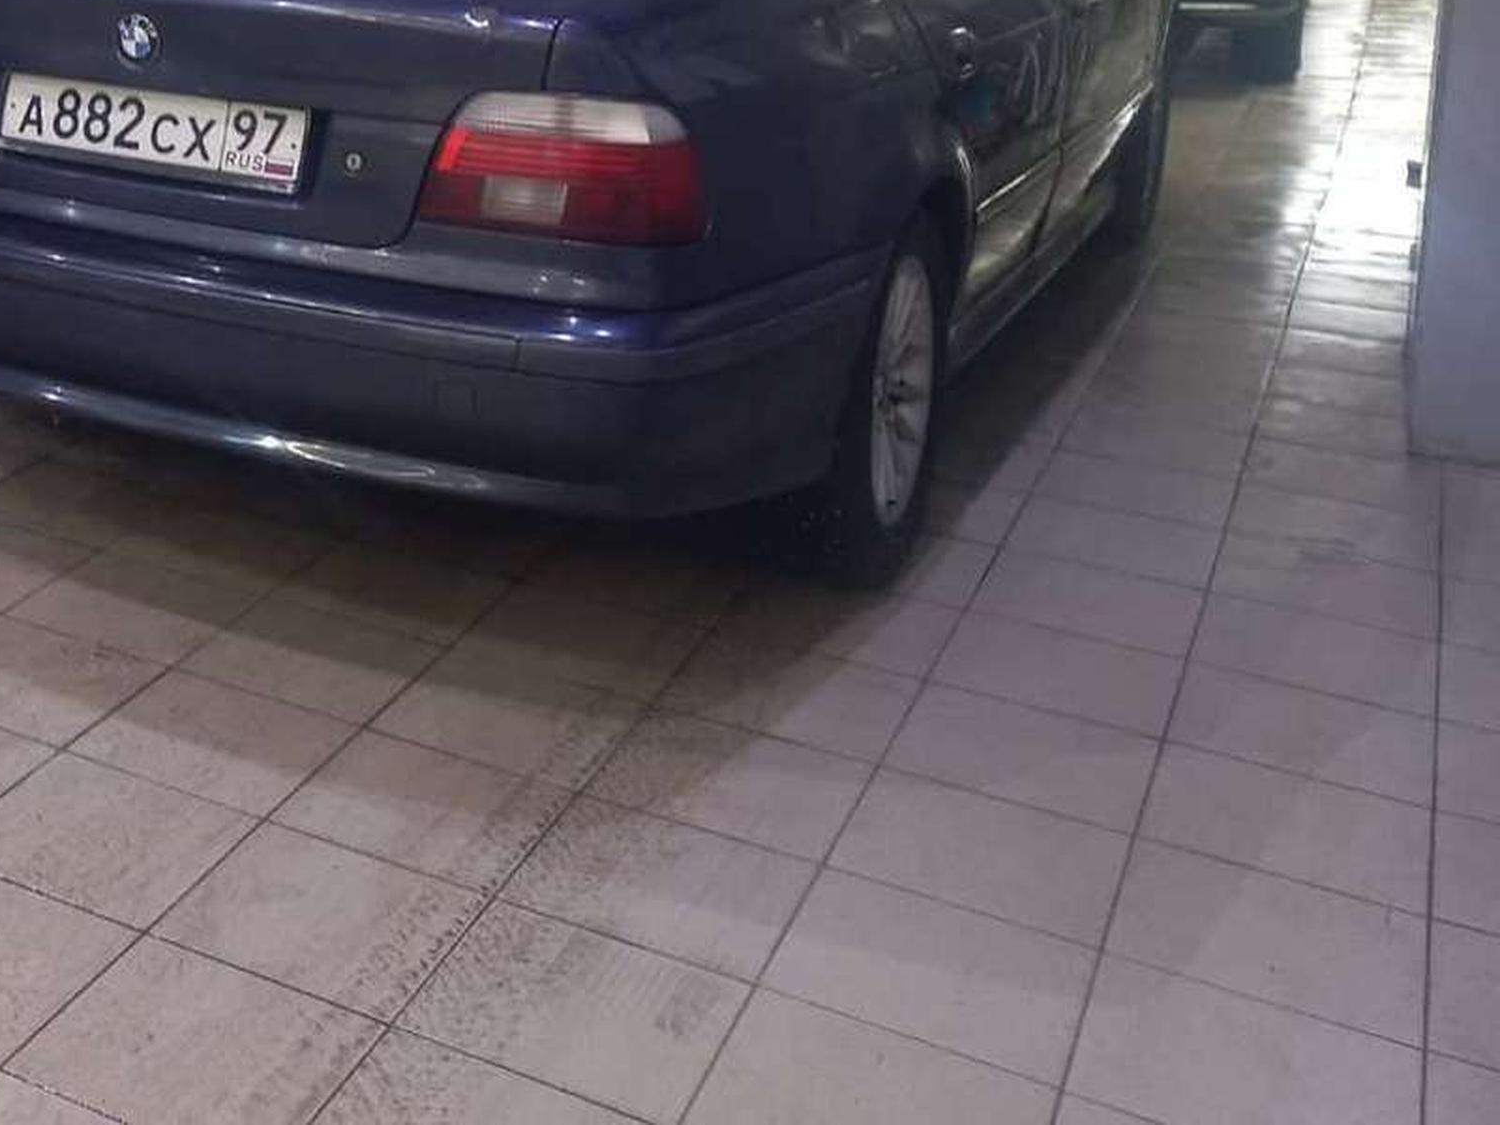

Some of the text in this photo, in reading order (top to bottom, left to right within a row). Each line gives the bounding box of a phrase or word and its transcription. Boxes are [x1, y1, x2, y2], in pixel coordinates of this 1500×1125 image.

[17, 87, 288, 162] А882СХ 97
[225, 150, 264, 172] RUS
